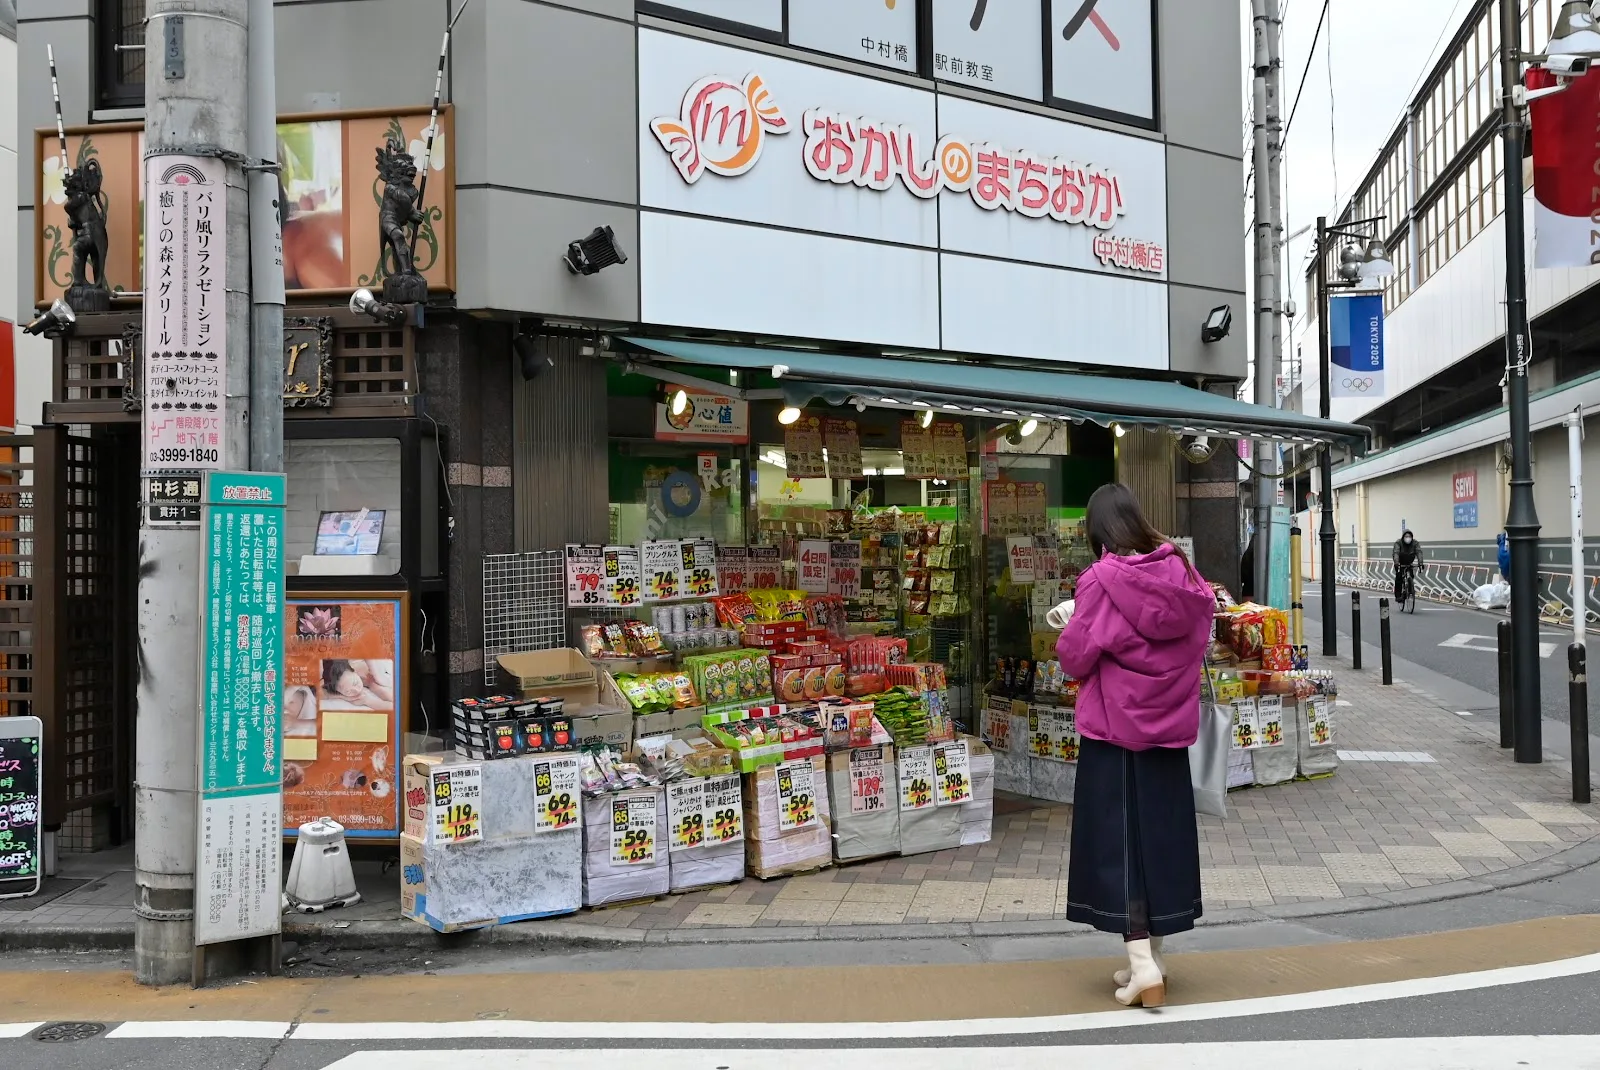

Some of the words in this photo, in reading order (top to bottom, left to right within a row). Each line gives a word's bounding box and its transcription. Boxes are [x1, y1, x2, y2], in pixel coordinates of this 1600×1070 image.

[861, 36, 908, 63] 中村橋
[935, 53, 993, 82] 駅前教室
[808, 114, 1121, 224] おかしのまちおか
[1094, 235, 1163, 272] 中村橋店
[159, 190, 174, 348] 癒しの森メグリール
[195, 190, 213, 348] バリ風リラクゼーション
[1370, 315, 1380, 343] TOKYO
[1370, 345, 1380, 366] 2020
[222, 485, 273, 500] 放置禁止
[1455, 476, 1475, 499] SEIYU
[645, 550, 678, 559] プリングルス
[801, 548, 828, 565] 4日間
[803, 565, 826, 578] 限定!
[436, 783, 451, 798] 48
